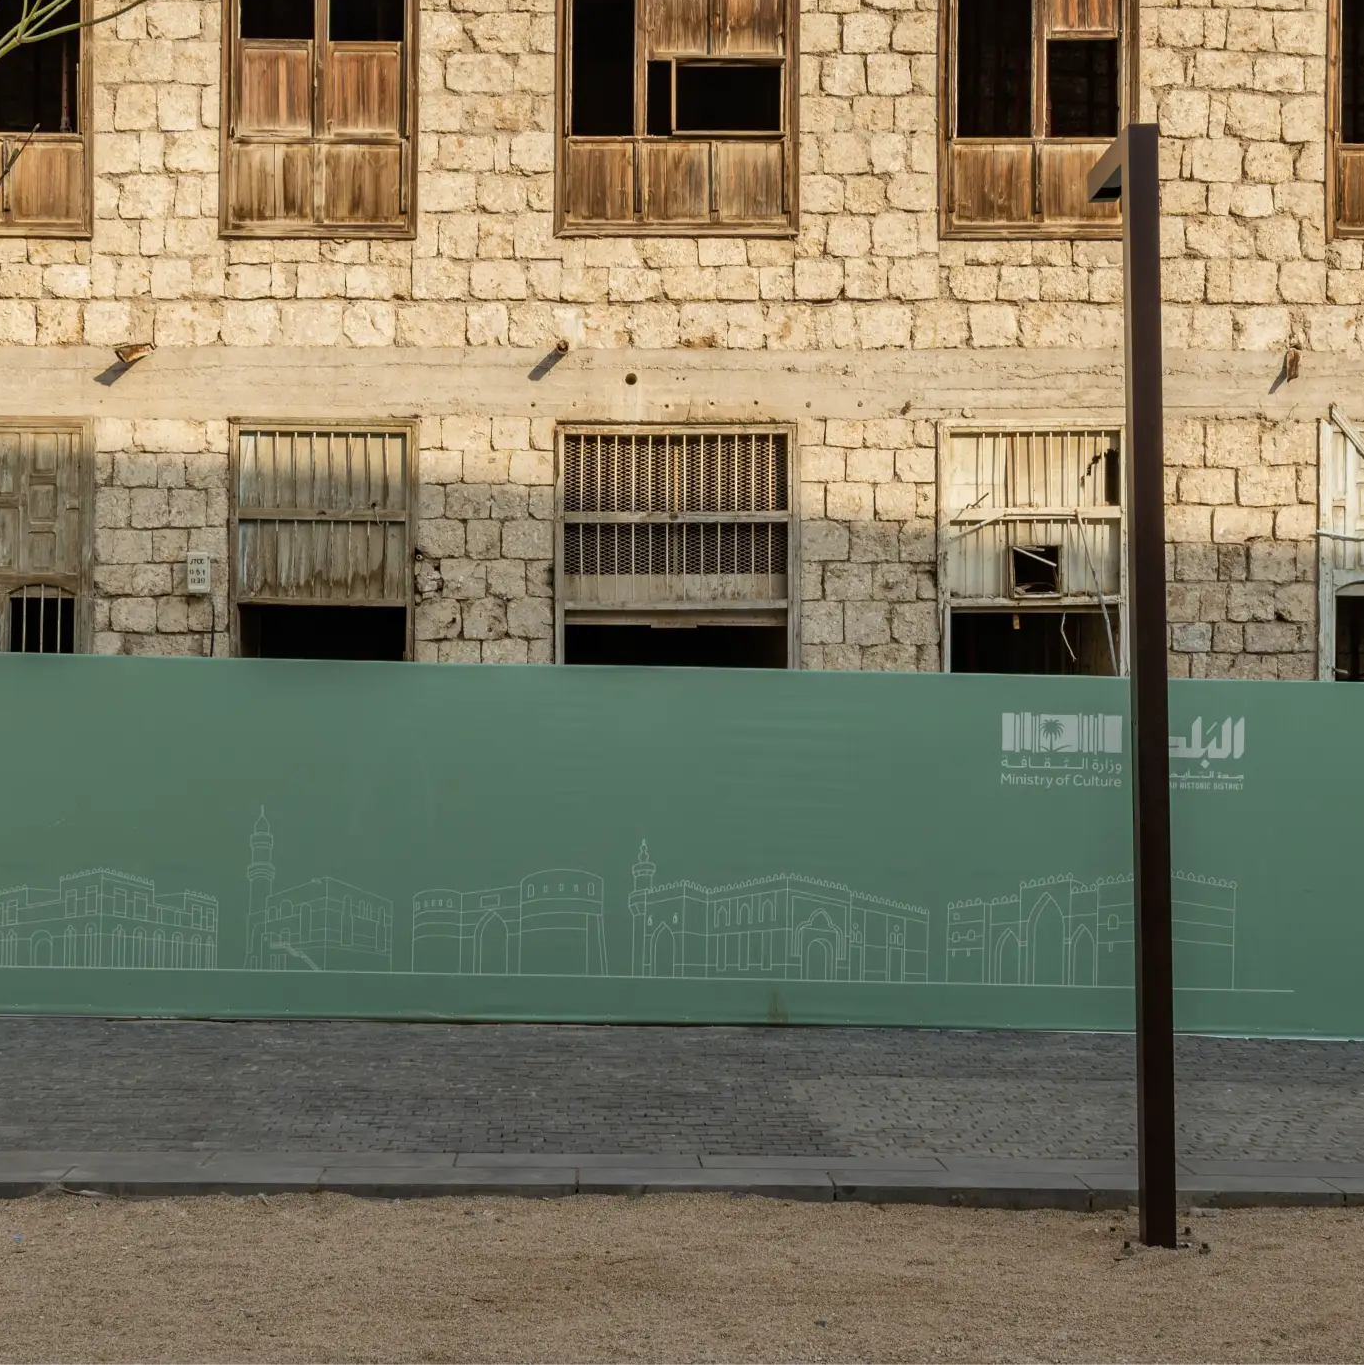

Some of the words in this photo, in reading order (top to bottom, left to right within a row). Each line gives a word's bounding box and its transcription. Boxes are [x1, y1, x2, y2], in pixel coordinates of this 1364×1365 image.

[1001, 754, 1088, 769] الثقافة
[1092, 757, 1122, 774] وزارة
[1000, 773, 1053, 789] Ministry
[1055, 774, 1071, 786] of
[1073, 774, 1122, 787] Culture
[1179, 782, 1211, 790] HISTORIC
[1213, 782, 1244, 790] DISTRICT
